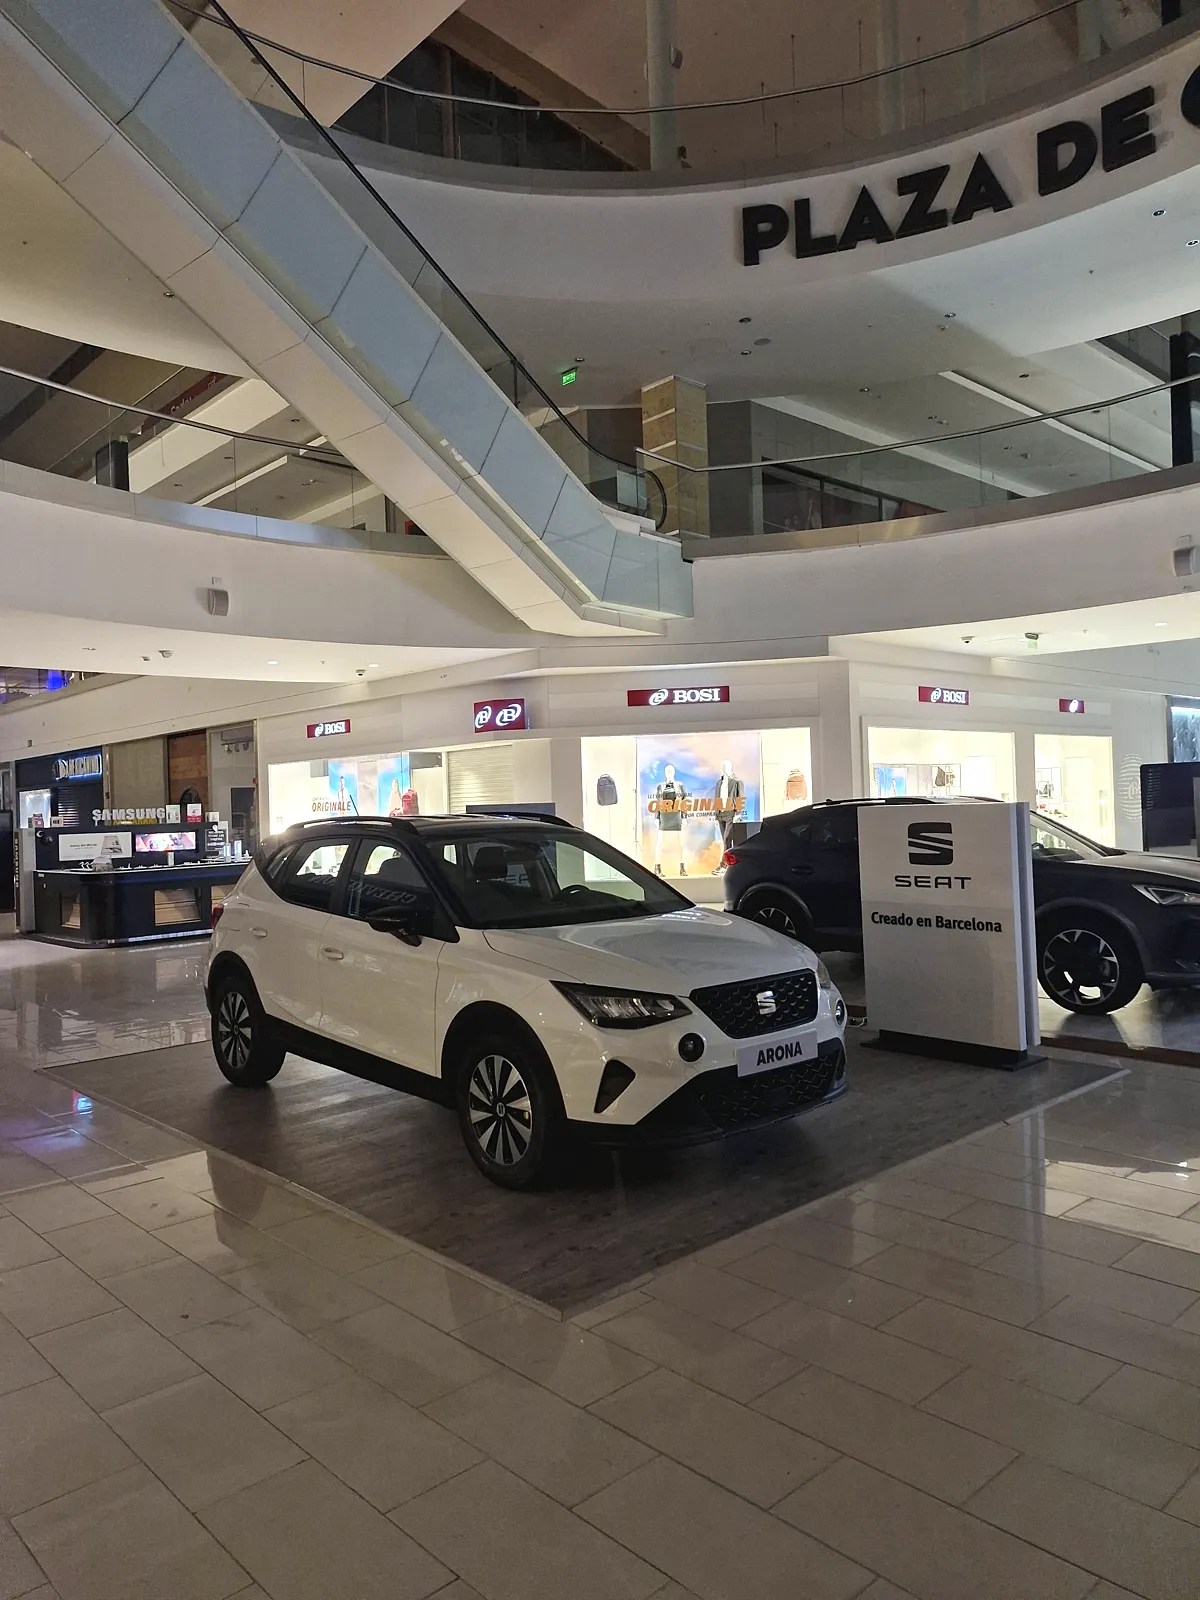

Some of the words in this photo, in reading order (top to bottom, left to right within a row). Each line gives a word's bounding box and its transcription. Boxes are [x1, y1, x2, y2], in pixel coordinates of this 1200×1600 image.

[742, 152, 1014, 266] PLAZA
[1036, 85, 1157, 197] DE
[673, 688, 720, 703] BOSI
[942, 690, 966, 703] BOSI
[324, 721, 346, 734] BOSI
[311, 801, 351, 812] ORIGINALE
[648, 797, 747, 813] ORIGINALE
[91, 807, 165, 821] SAMSUNG
[894, 875, 971, 889] SEAT
[871, 911, 913, 926] Creado
[916, 917, 932, 927] en
[935, 915, 1003, 933] Barcelona
[757, 1041, 802, 1066] ARONA
